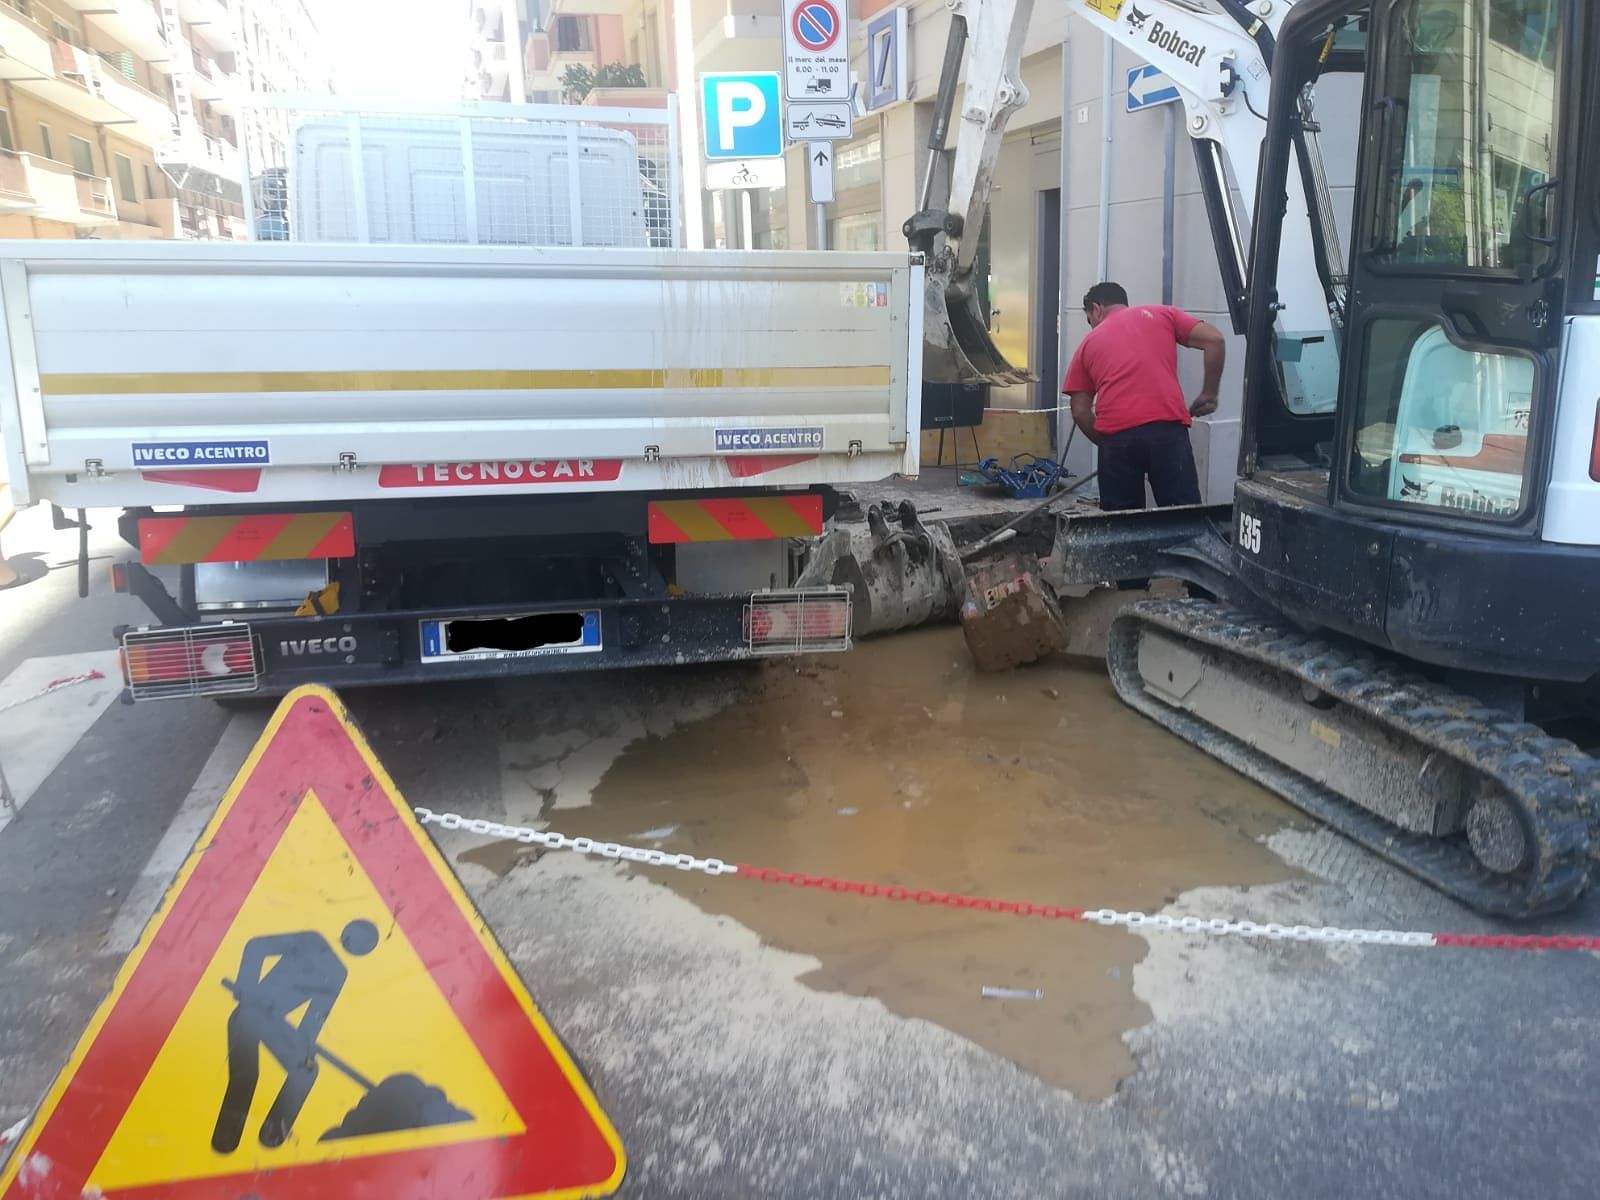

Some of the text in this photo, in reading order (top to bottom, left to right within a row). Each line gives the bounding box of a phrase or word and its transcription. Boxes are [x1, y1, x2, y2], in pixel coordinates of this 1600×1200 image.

[1147, 21, 1207, 67] Bobcat
[716, 81, 766, 150] P
[717, 432, 822, 445] IVECO ACENTRO
[135, 446, 266, 461] IVECO ACENTRO
[411, 459, 595, 482] TECNOCAR
[1240, 511, 1261, 554] E35
[280, 636, 357, 656] IVECO
